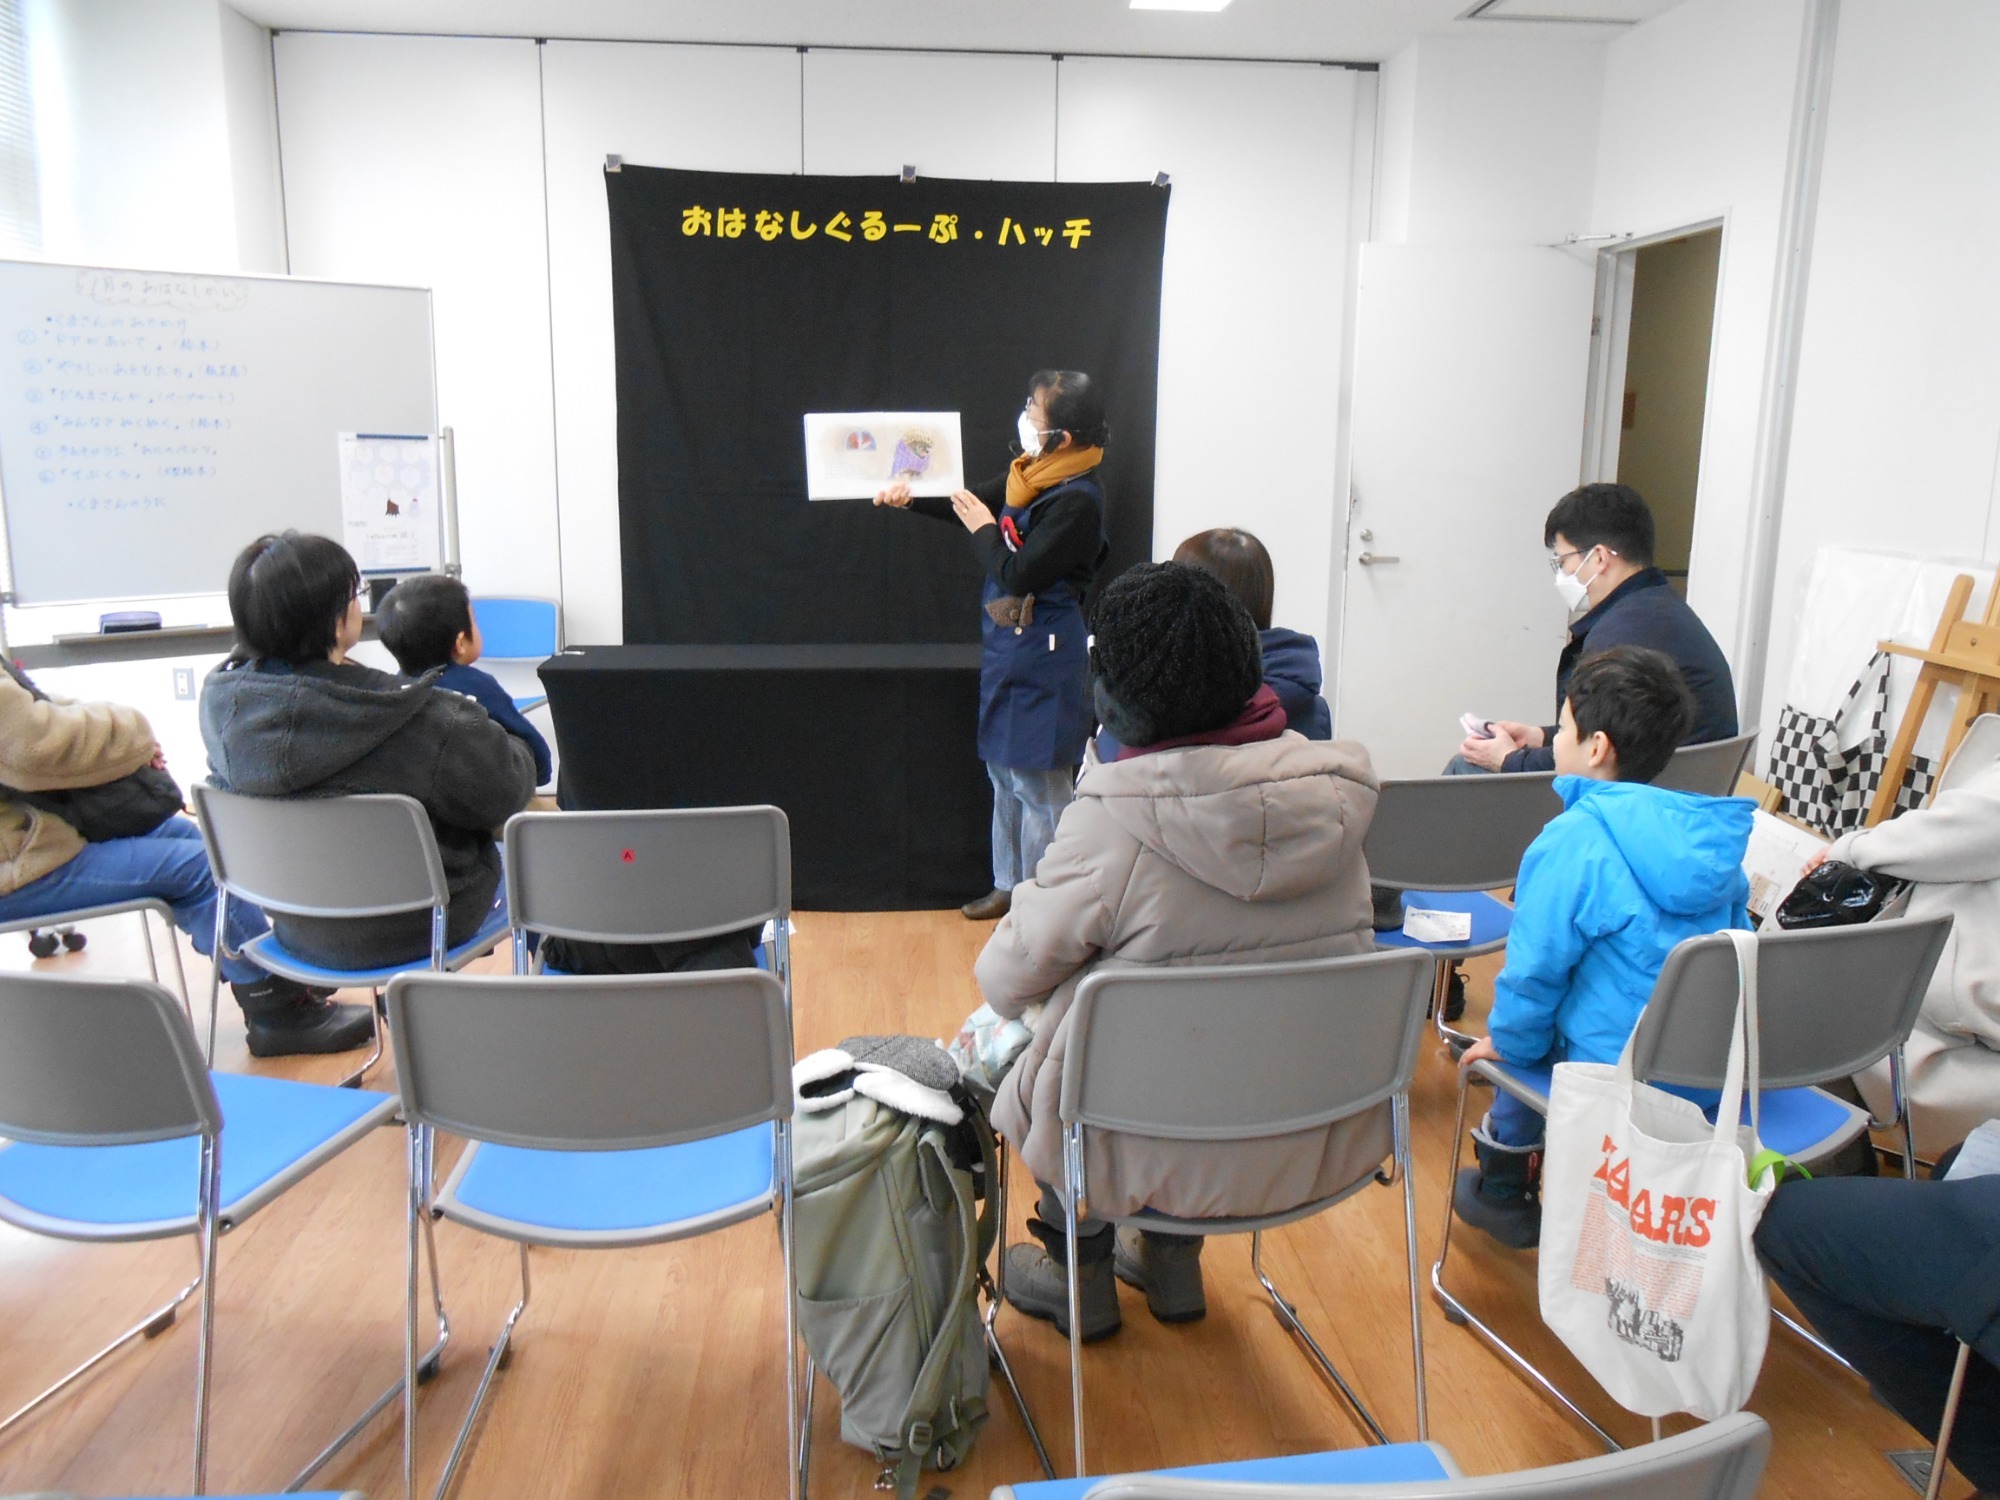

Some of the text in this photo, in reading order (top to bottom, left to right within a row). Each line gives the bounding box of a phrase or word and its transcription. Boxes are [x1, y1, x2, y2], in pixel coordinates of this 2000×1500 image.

[681, 205, 1092, 249] おはなしぐるーぷ・ハッチ
